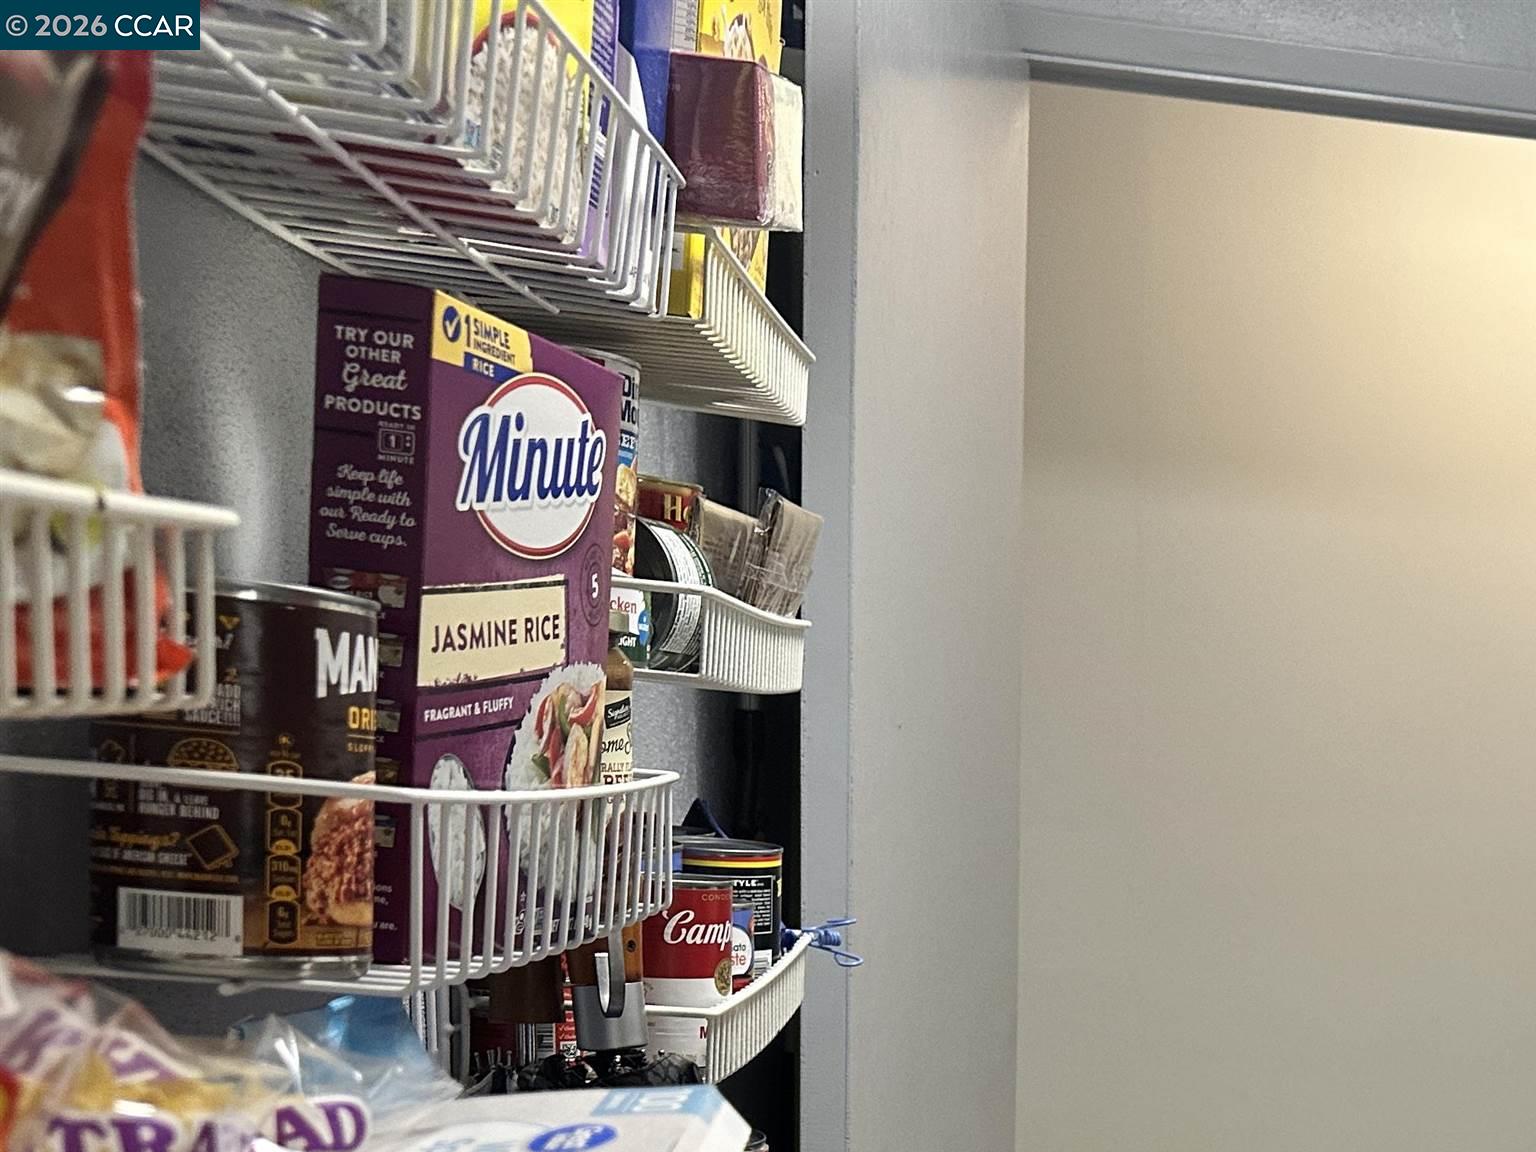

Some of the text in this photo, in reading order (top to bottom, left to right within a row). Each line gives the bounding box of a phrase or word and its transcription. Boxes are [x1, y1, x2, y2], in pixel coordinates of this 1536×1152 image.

[334, 325, 415, 349] TRY OUR
[464, 314, 510, 350] 1 SIMPLE
[346, 345, 401, 364] OTHER
[473, 340, 516, 365] INGREDIENT
[342, 361, 408, 392] Great
[472, 358, 495, 378] RICE
[324, 395, 422, 420] PRODUCTS
[378, 454, 415, 464] MINUTE
[459, 411, 604, 505] Minute
[337, 463, 404, 489] Keep life
[327, 485, 412, 507] simple with
[319, 506, 416, 530] our Ready to
[326, 523, 408, 549] Serve cups.
[591, 573, 599, 599] 5
[431, 613, 561, 654] JASMINE RICE
[424, 696, 514, 722] FRAGRANT & FLUFFY
[179, 804, 220, 820] BEHIND
